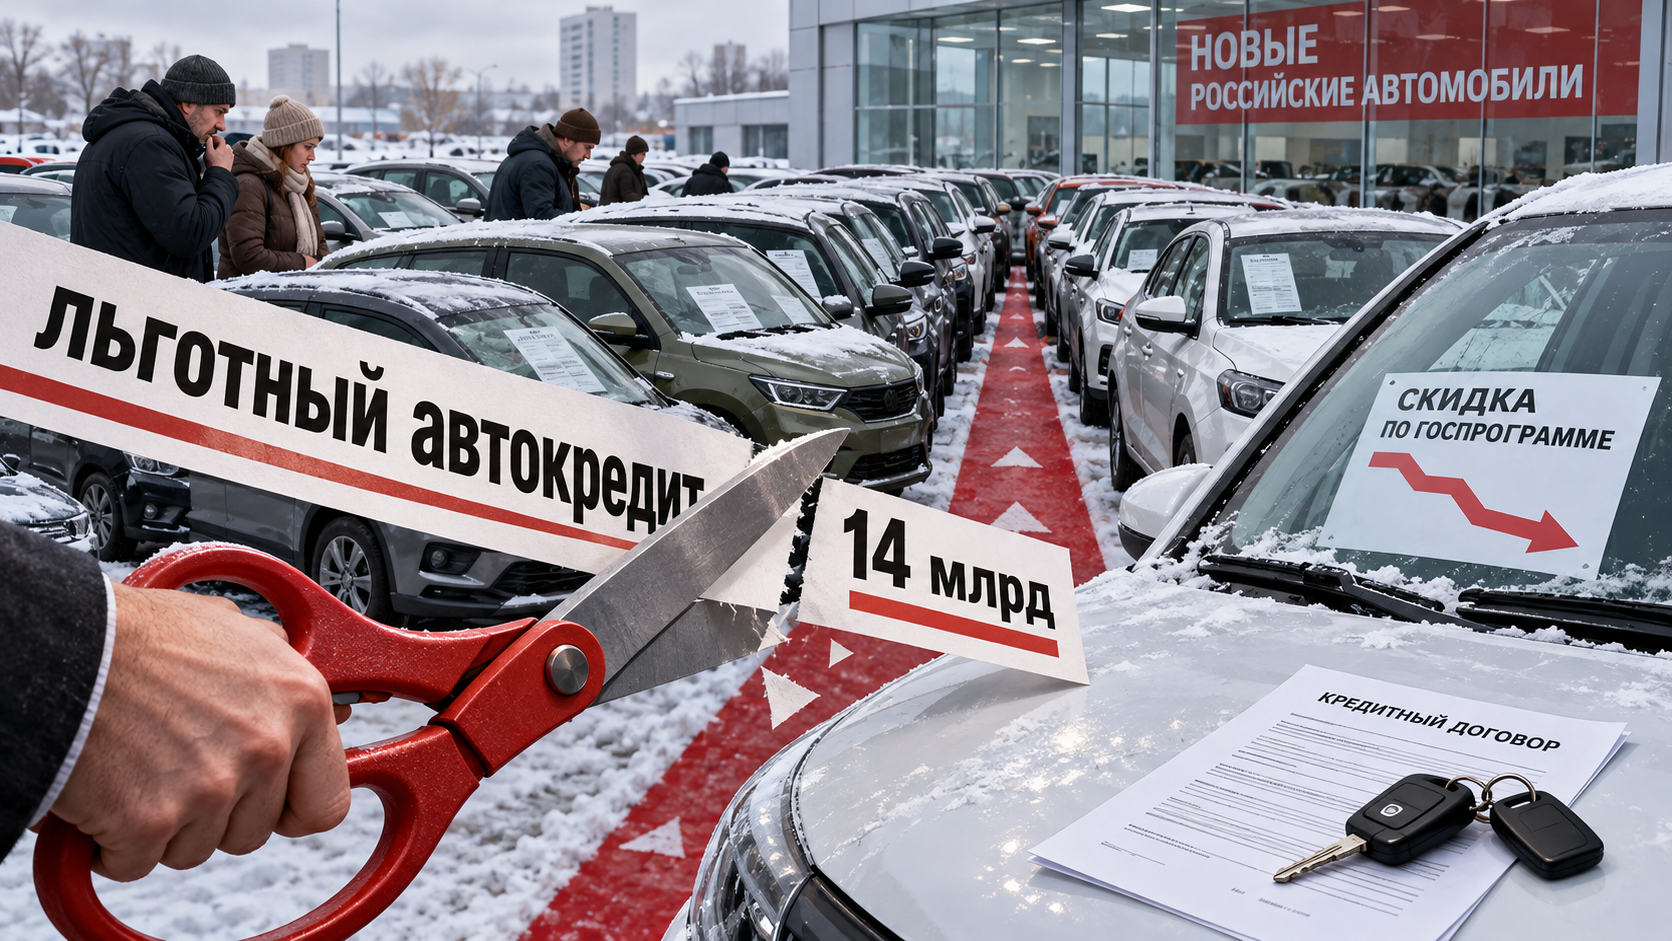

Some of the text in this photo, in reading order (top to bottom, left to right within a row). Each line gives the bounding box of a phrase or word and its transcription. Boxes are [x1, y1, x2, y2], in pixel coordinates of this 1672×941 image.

[1191, 23, 1317, 70] НОВЫЕ
[1191, 64, 1584, 110] РОССИЙСКИЕ АВТОМОБИЛИ
[1398, 388, 1536, 416] СКИДКА
[1380, 421, 1615, 450] ПО ГОСПРОГРАММЕ
[412, 401, 704, 534] автокредит
[844, 509, 1056, 629] 14 млрд
[1317, 691, 1561, 752] КРЕДИТНЫЙ ДОГОВОР
